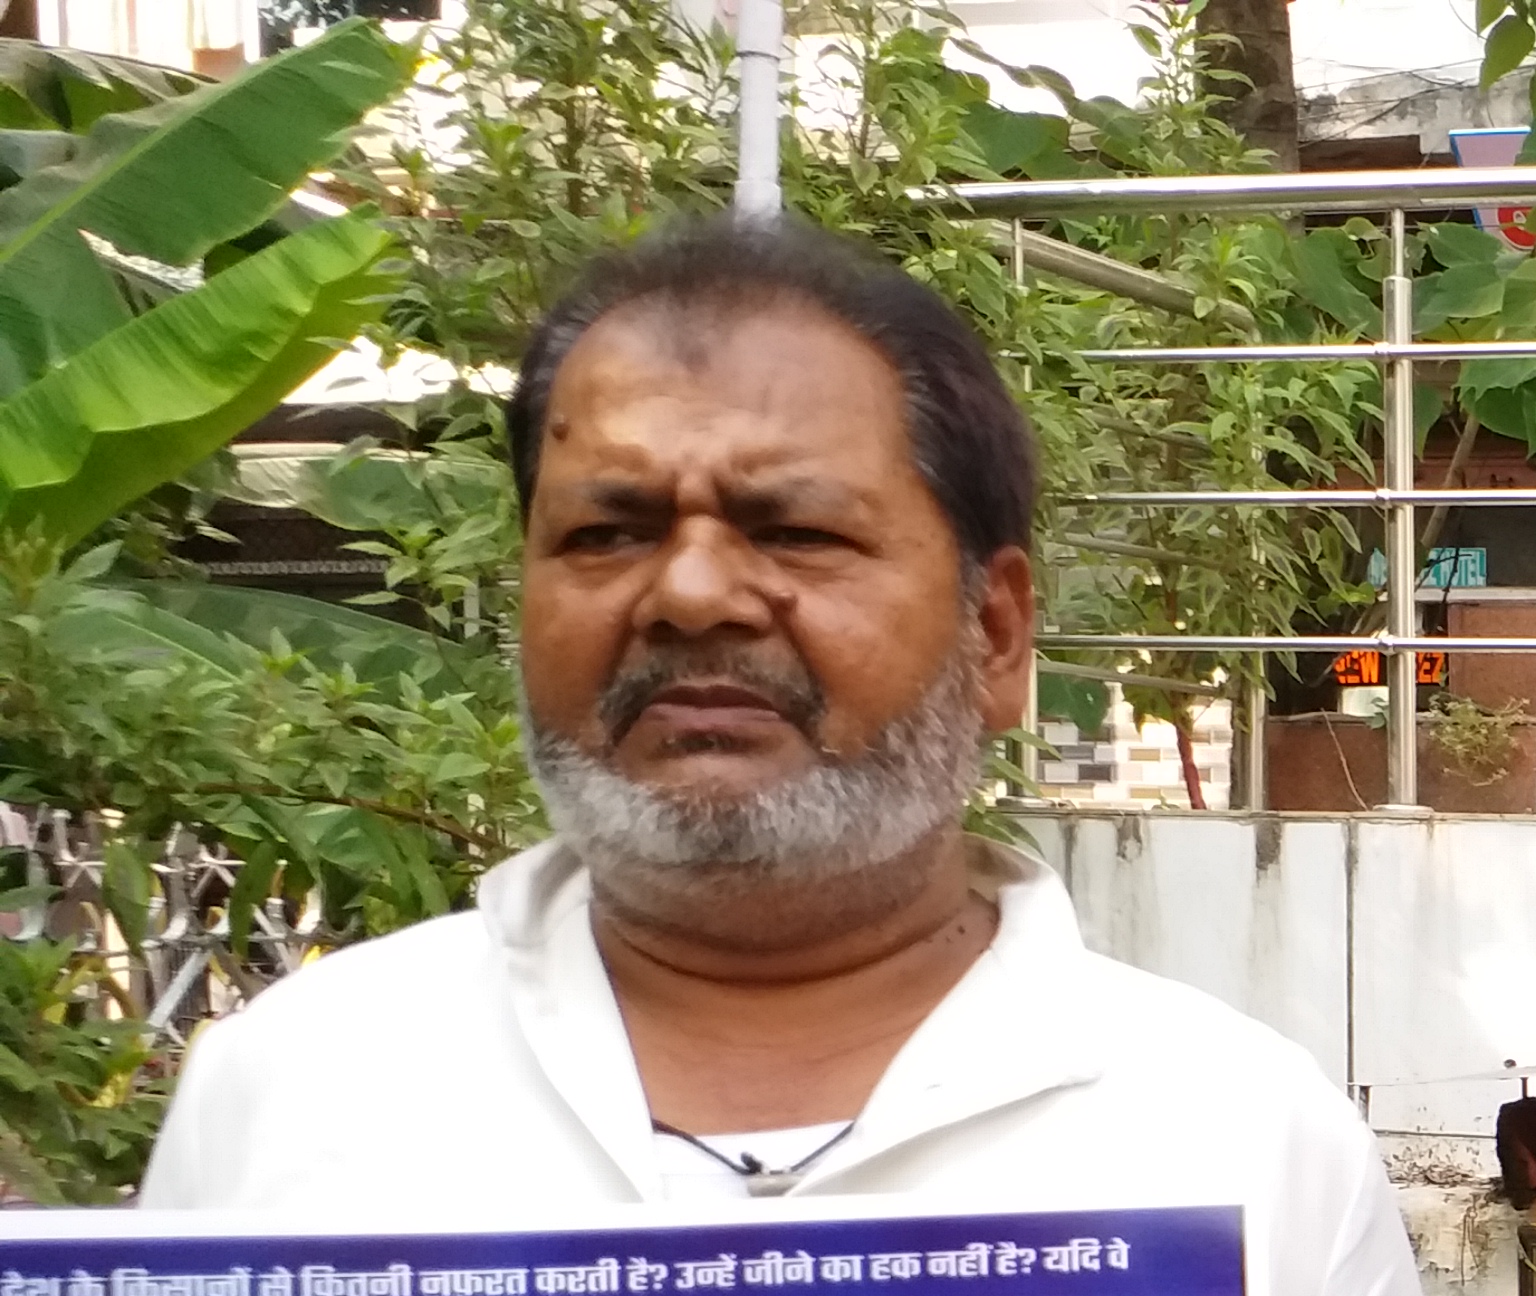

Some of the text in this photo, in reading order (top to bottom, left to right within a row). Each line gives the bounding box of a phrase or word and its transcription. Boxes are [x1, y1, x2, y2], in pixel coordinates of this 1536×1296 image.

[534, 1258, 620, 1295] करती
[627, 1256, 669, 1293] है?
[675, 1251, 738, 1290] उन्हें
[743, 1250, 814, 1287] जीने
[820, 1252, 865, 1283] का
[869, 1250, 922, 1282] हक
[926, 1242, 991, 1277] नहीं
[995, 1241, 1037, 1275] है?
[1041, 1237, 1102, 1273] यदि
[1106, 1236, 1131, 1271] वे
